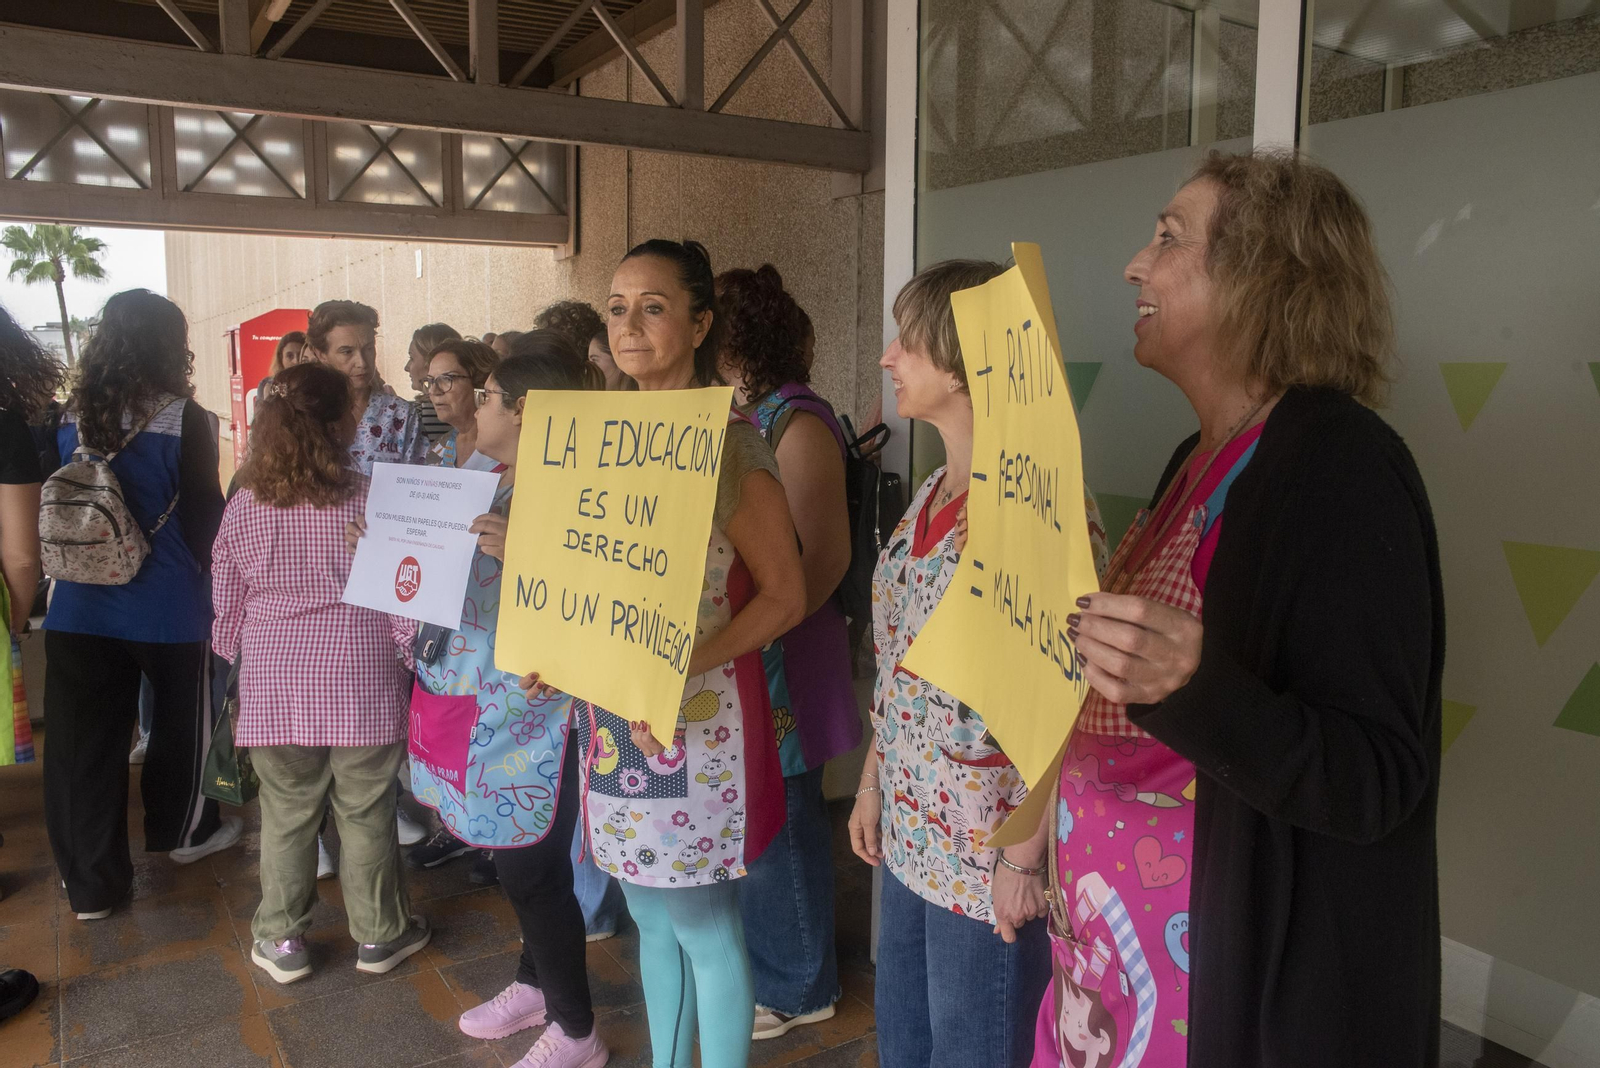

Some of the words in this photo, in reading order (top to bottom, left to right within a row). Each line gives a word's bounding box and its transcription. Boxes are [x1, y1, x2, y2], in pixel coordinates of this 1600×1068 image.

[1006, 319, 1054, 406] RATIO
[543, 416, 576, 469] LA
[598, 413, 724, 478] EDUCACIÓN
[406, 477, 420, 486] NIÑOS
[424, 479, 438, 488] NIÑAS
[438, 481, 462, 490] MENORES
[578, 488, 608, 519] ES
[624, 494, 658, 527] UN
[998, 449, 1061, 533] PERSONAL
[392, 514, 412, 524] MUEBLES
[418, 518, 437, 527] PAPELES
[438, 521, 448, 529] QUE
[448, 522, 468, 531] PUEDEN
[401, 564, 418, 585] UGT
[563, 528, 668, 577] DERECHO
[516, 575, 548, 611] NO
[561, 589, 600, 626] UN
[610, 597, 692, 675] PRIVILEGIO
[993, 568, 1034, 647] MALA
[1039, 606, 1085, 705] CALIDA
[437, 766, 459, 782] PRADA
